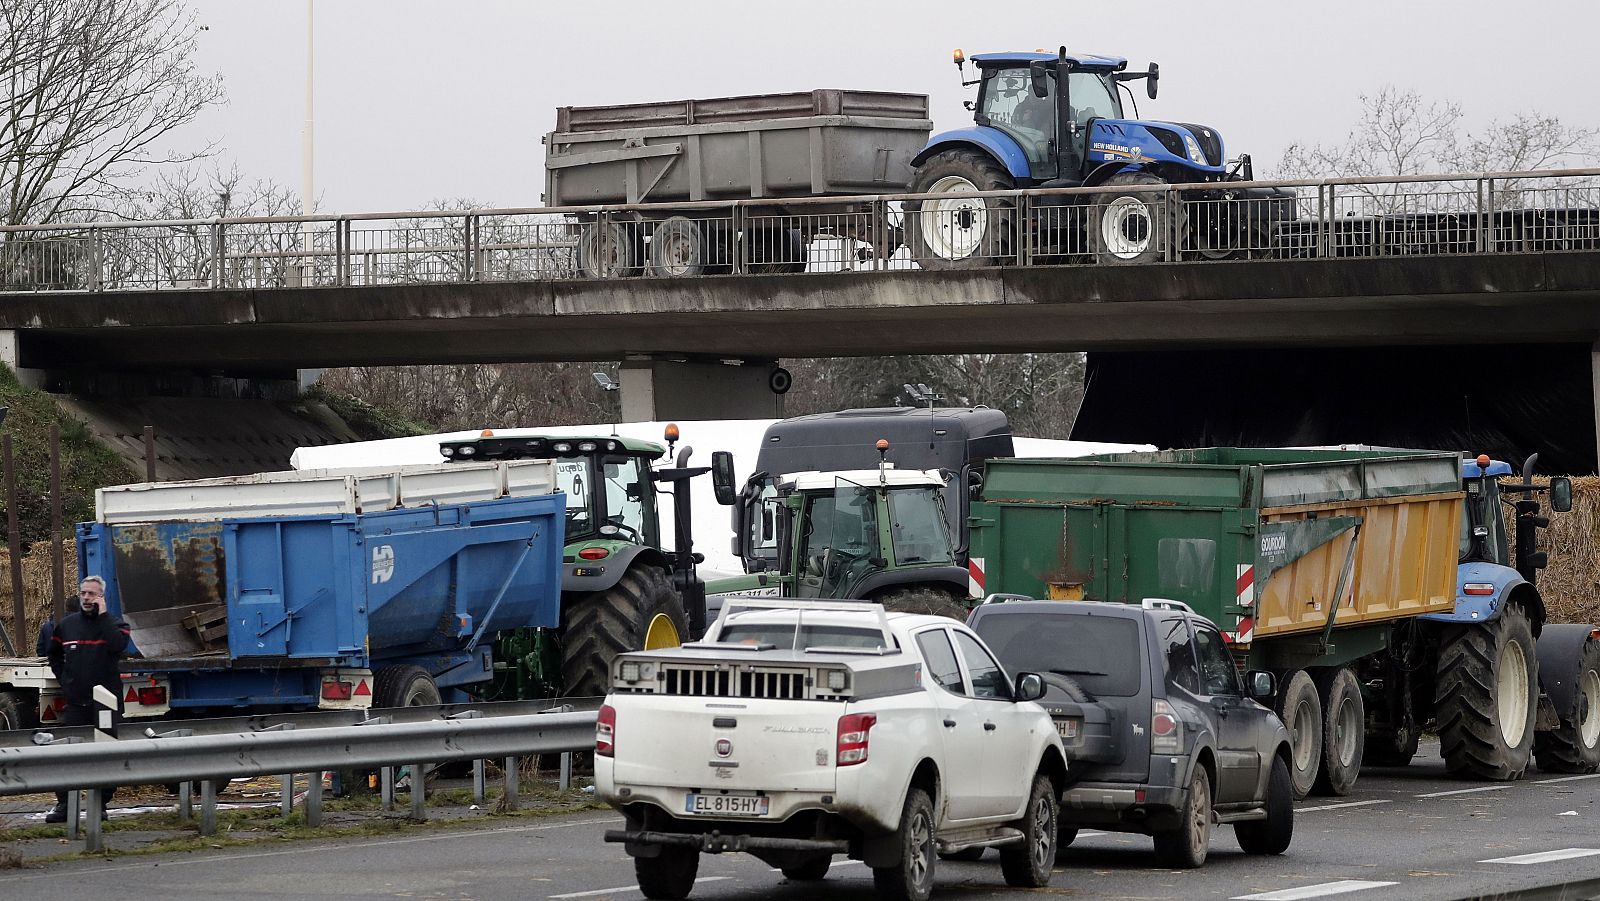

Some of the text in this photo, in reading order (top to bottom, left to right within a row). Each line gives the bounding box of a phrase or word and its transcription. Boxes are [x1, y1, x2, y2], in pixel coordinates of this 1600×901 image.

[1093, 142, 1129, 152] NEW HOLLAND
[1261, 536, 1286, 552] GOURDON
